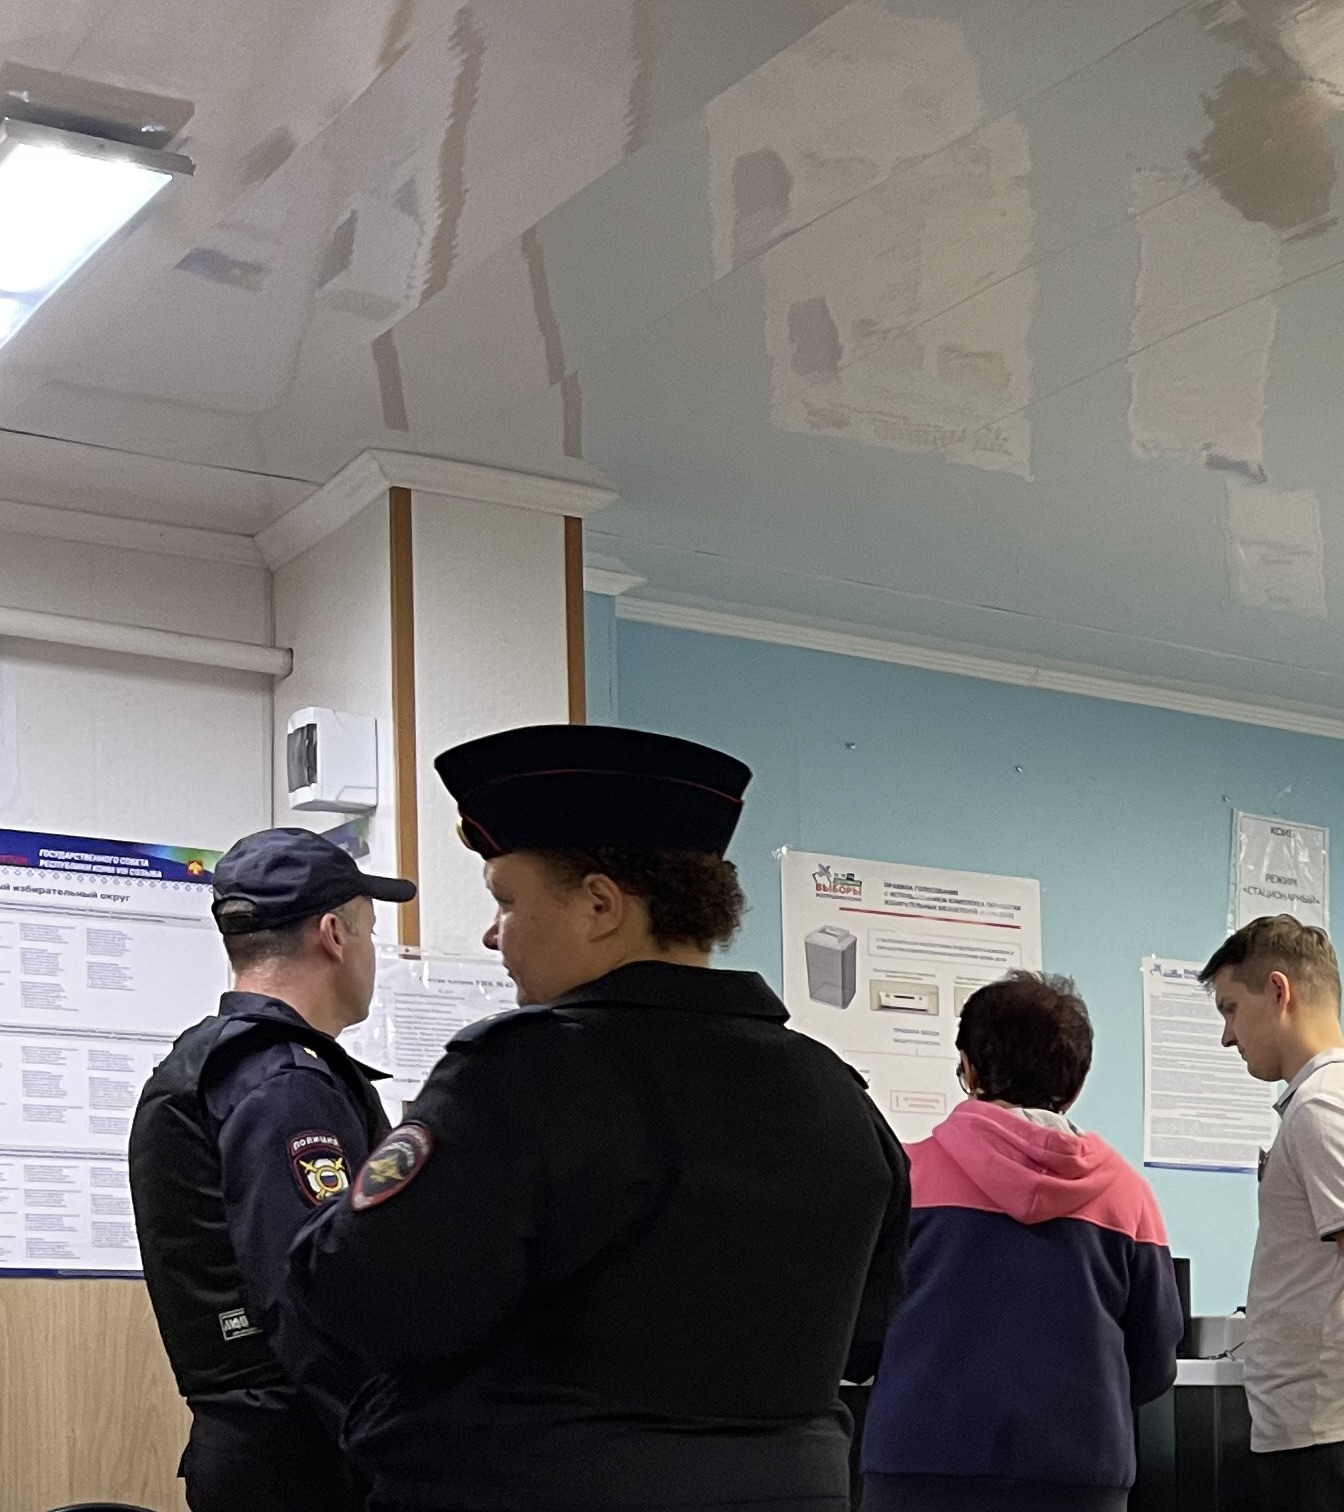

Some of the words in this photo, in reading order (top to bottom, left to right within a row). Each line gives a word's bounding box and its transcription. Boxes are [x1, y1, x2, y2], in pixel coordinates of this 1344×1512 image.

[13, 885, 98, 899] избирательный
[100, 892, 131, 903] округ
[815, 882, 862, 895] ВЫБОРЫ
[293, 1136, 339, 1151] ПОЛИЦИЯ
